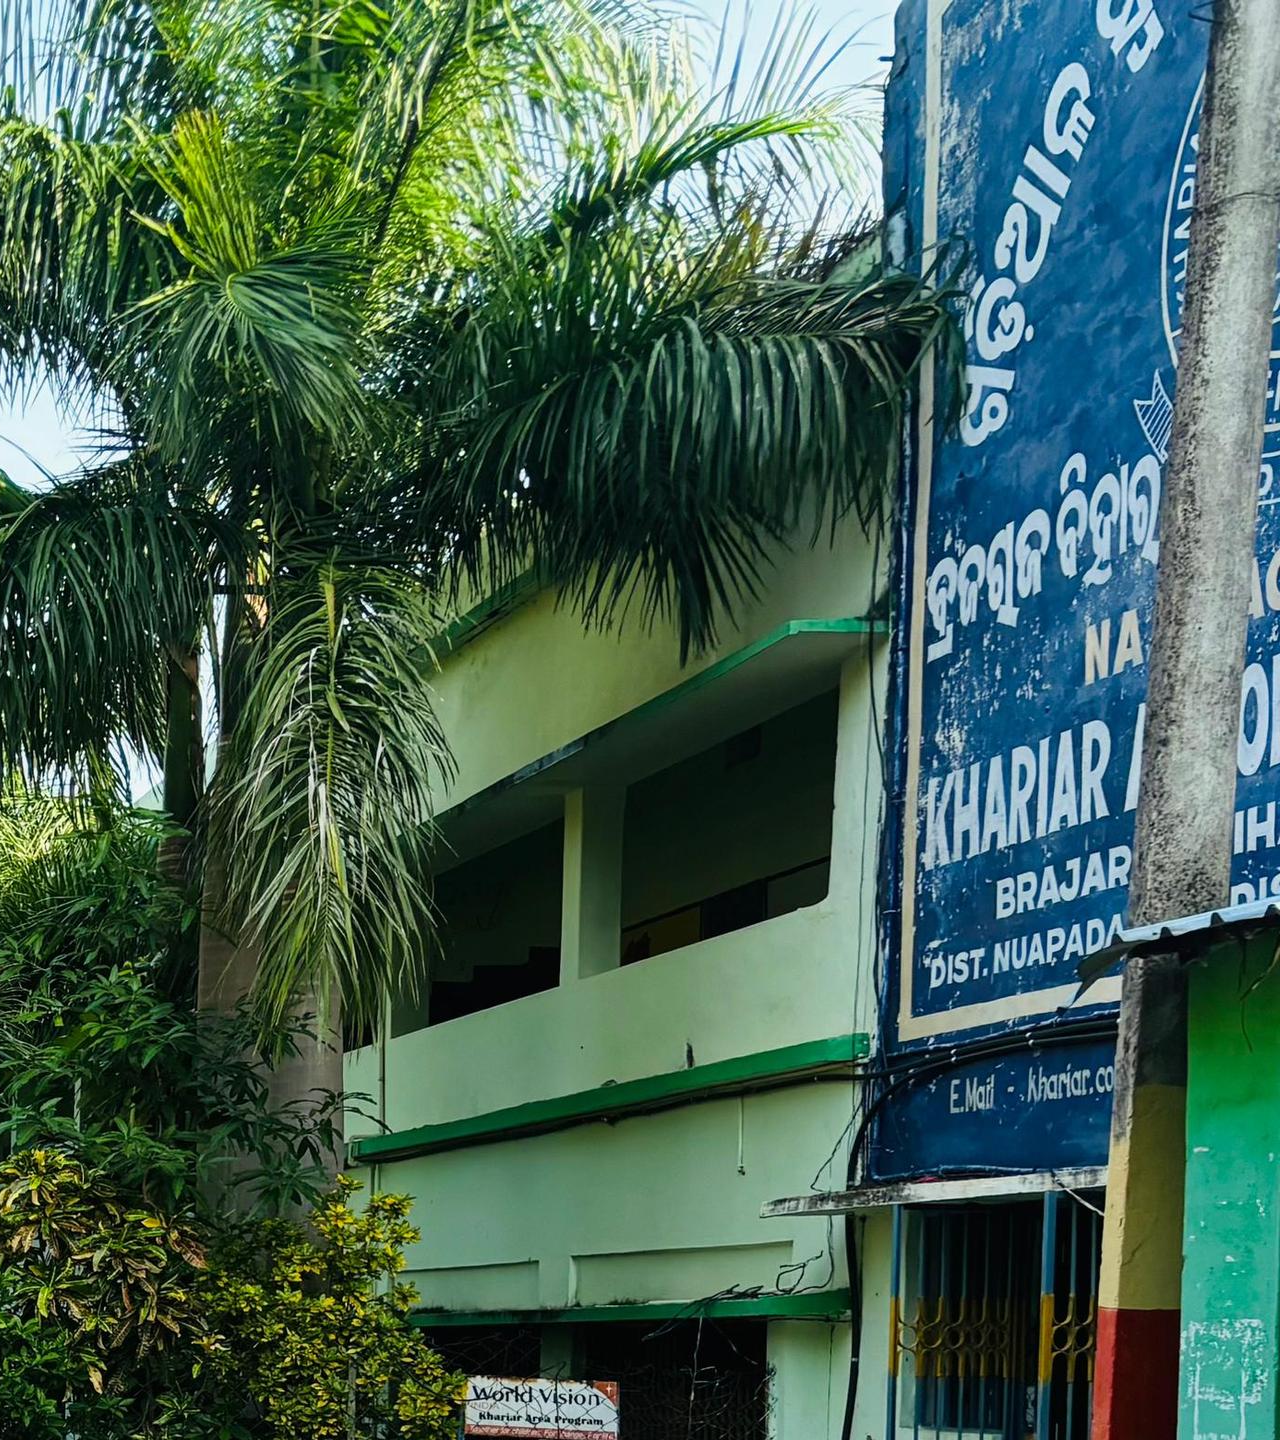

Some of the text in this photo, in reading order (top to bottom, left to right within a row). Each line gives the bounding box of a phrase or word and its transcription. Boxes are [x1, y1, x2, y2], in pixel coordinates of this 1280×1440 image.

[924, 719, 1112, 872] KHARIAR
[996, 845, 1132, 920] BRAJAR
[929, 948, 988, 989] DIST.
[950, 1073, 995, 1114] E.Mail
[472, 1385, 601, 1407] World Vision
[479, 1412, 603, 1427] Khariar Area Program
